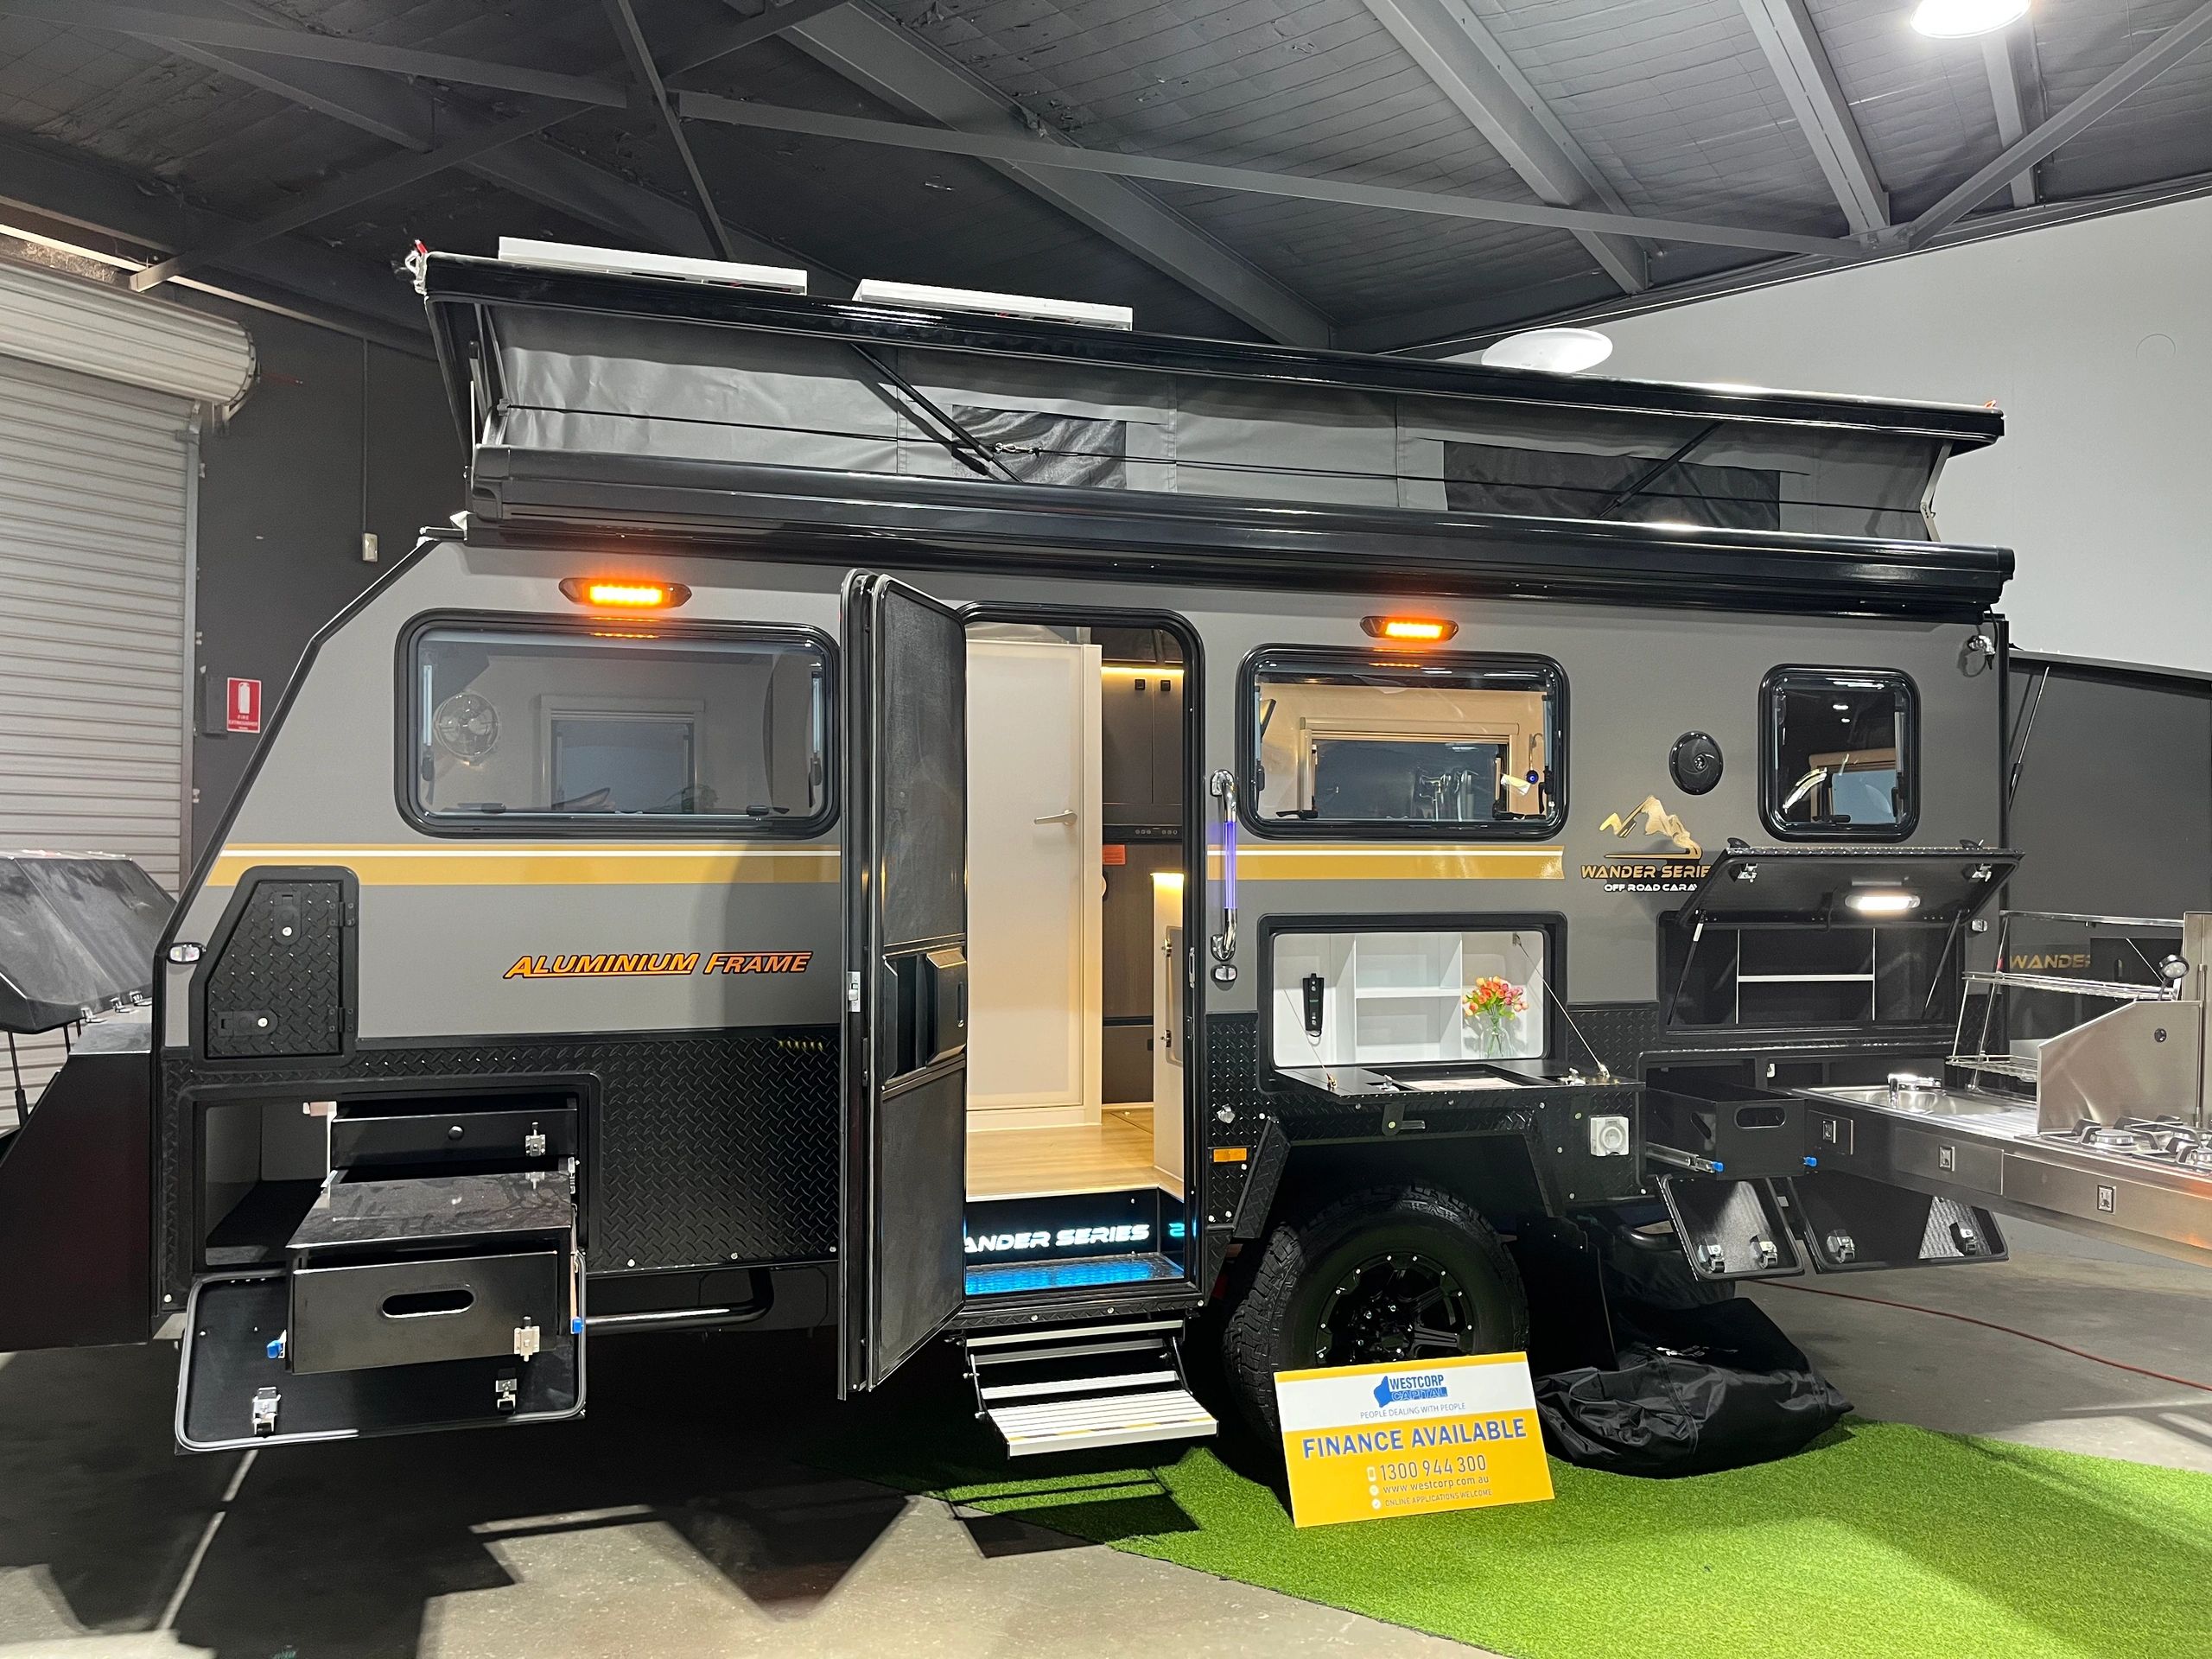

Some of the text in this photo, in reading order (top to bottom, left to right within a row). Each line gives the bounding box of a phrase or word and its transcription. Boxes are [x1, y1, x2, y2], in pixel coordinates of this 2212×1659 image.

[1580, 864, 1712, 880] WANDER SERIE
[1603, 883, 1698, 893] OFF ROAD CARA
[503, 950, 814, 979] ALUMINIUM FRAME
[964, 1230, 1052, 1254] ANDER
[1055, 1224, 1150, 1247] SERIES
[1389, 1374, 1445, 1390] WESTCORP
[1390, 1386, 1447, 1401] CAPITAL
[1360, 1402, 1466, 1419] PEOPLE DEALING WITH PEOPLE
[1302, 1418, 1527, 1459] FINANCE AVAILABLE
[1380, 1454, 1487, 1481] 1300 944 300
[1385, 1488, 1492, 1507] ONLINE APPLICATIONS WELCOME
